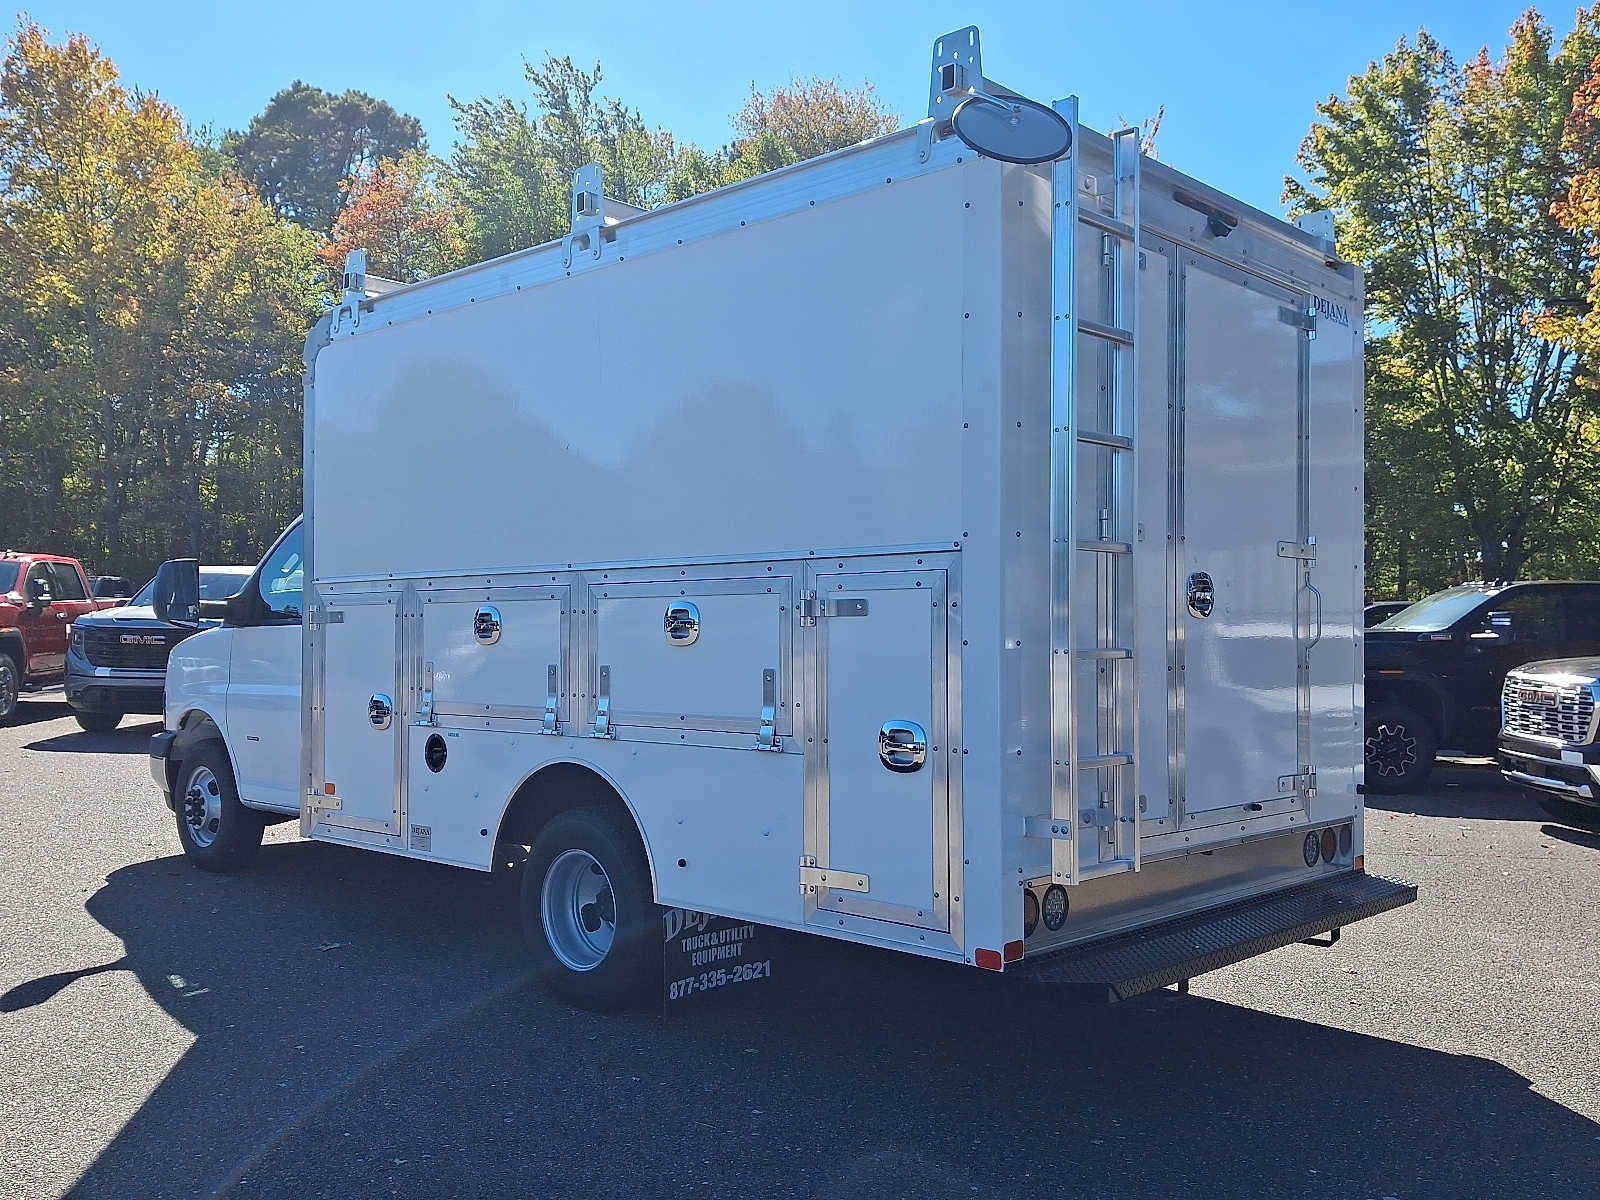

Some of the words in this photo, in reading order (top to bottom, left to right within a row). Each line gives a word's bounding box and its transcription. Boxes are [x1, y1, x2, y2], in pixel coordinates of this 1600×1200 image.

[1313, 295, 1348, 323] DEJANA
[120, 634, 165, 644] GMC
[691, 943, 743, 967] EQUIPMENT
[669, 960, 771, 1000] 877-335-2621
